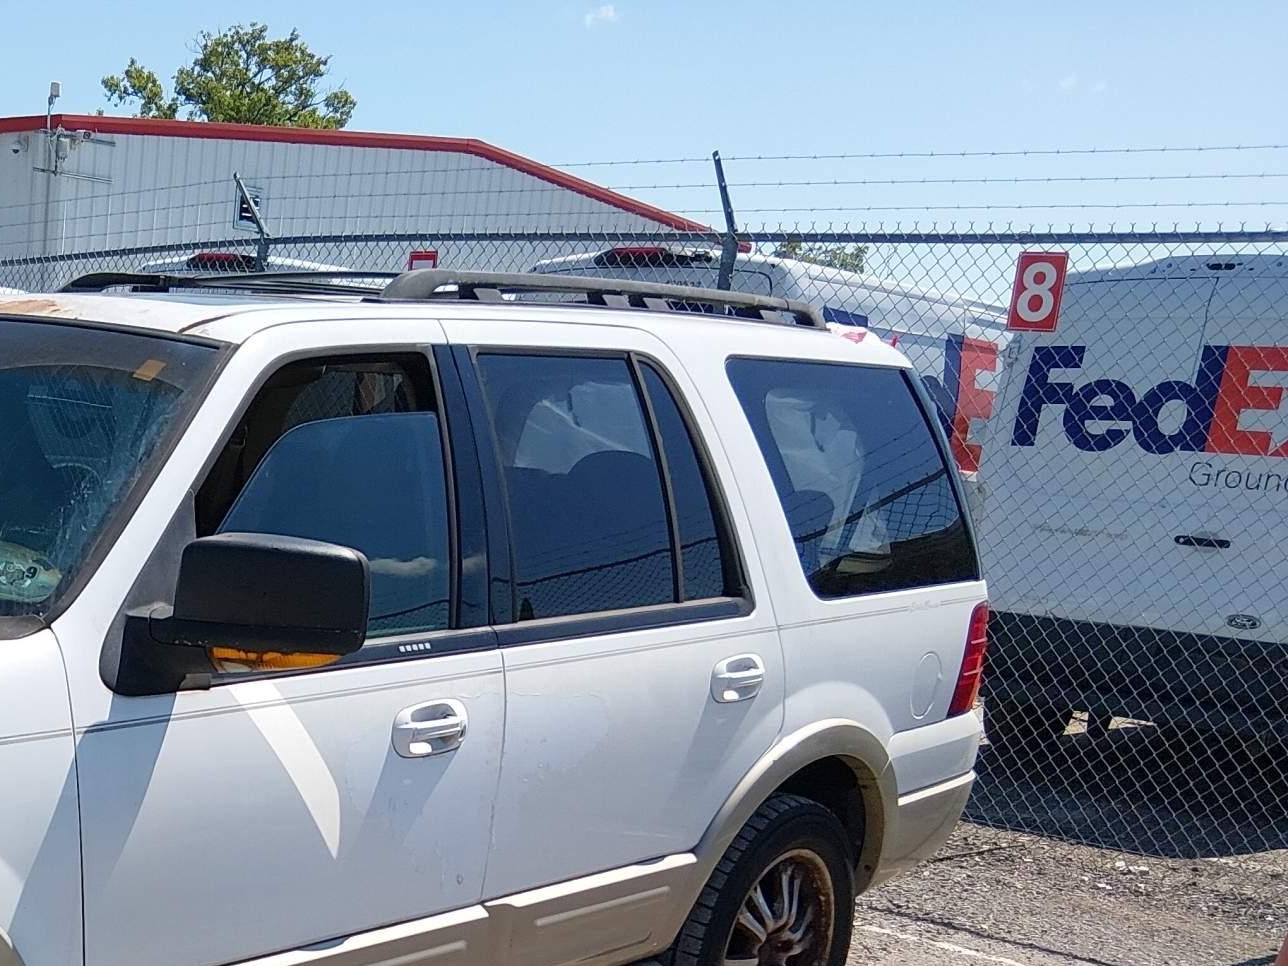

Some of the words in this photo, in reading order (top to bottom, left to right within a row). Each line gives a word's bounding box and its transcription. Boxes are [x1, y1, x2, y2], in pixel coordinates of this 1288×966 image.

[1016, 261, 1058, 322] 8
[1011, 345, 1288, 457] FedE
[1188, 461, 1288, 493] Groun
[24, 566, 38, 579] 9
